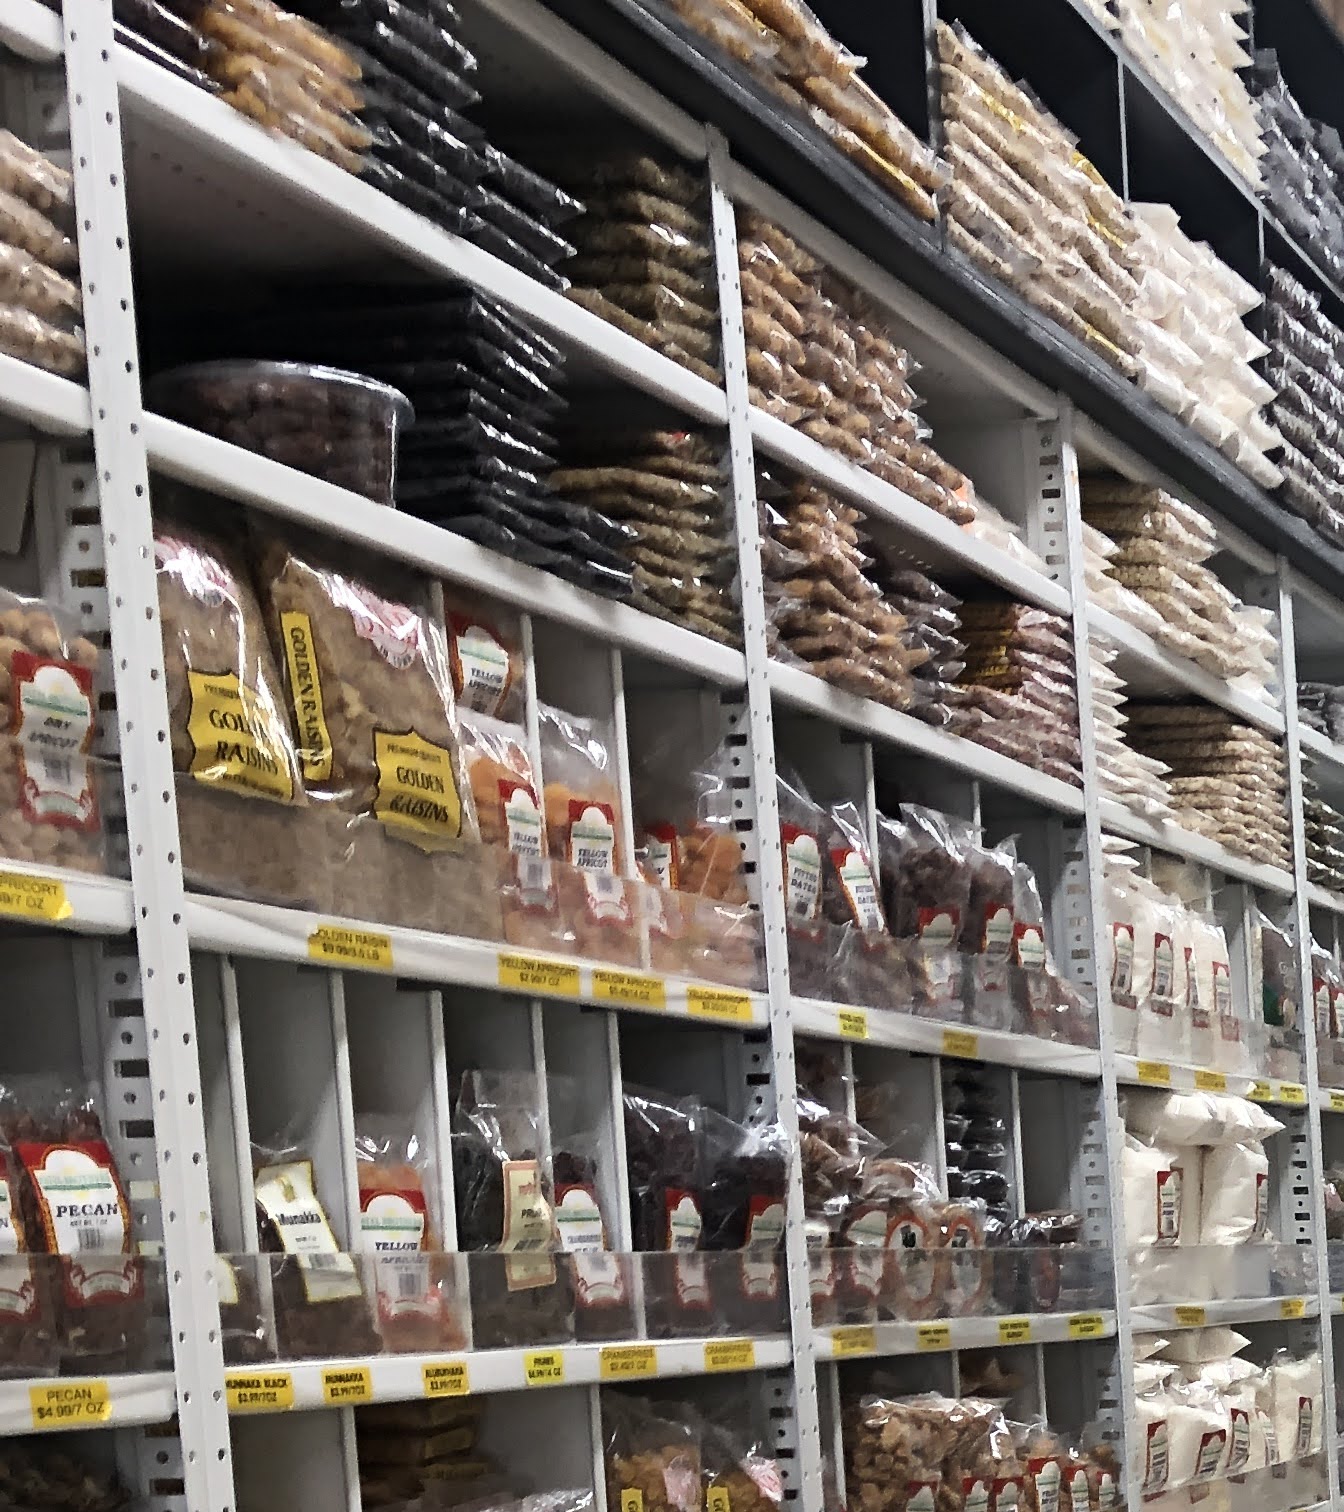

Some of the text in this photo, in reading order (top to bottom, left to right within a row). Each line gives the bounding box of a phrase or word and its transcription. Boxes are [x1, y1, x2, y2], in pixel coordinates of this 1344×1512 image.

[290, 627, 315, 697] GOLDEN
[396, 766, 444, 794] GOLDEN
[389, 797, 448, 824] RAISINS
[56, 1202, 118, 1219] PECAN
[374, 1241, 419, 1251] YELLOW
[46, 1389, 92, 1402] PECAN
[85, 1402, 105, 1415] OZ
